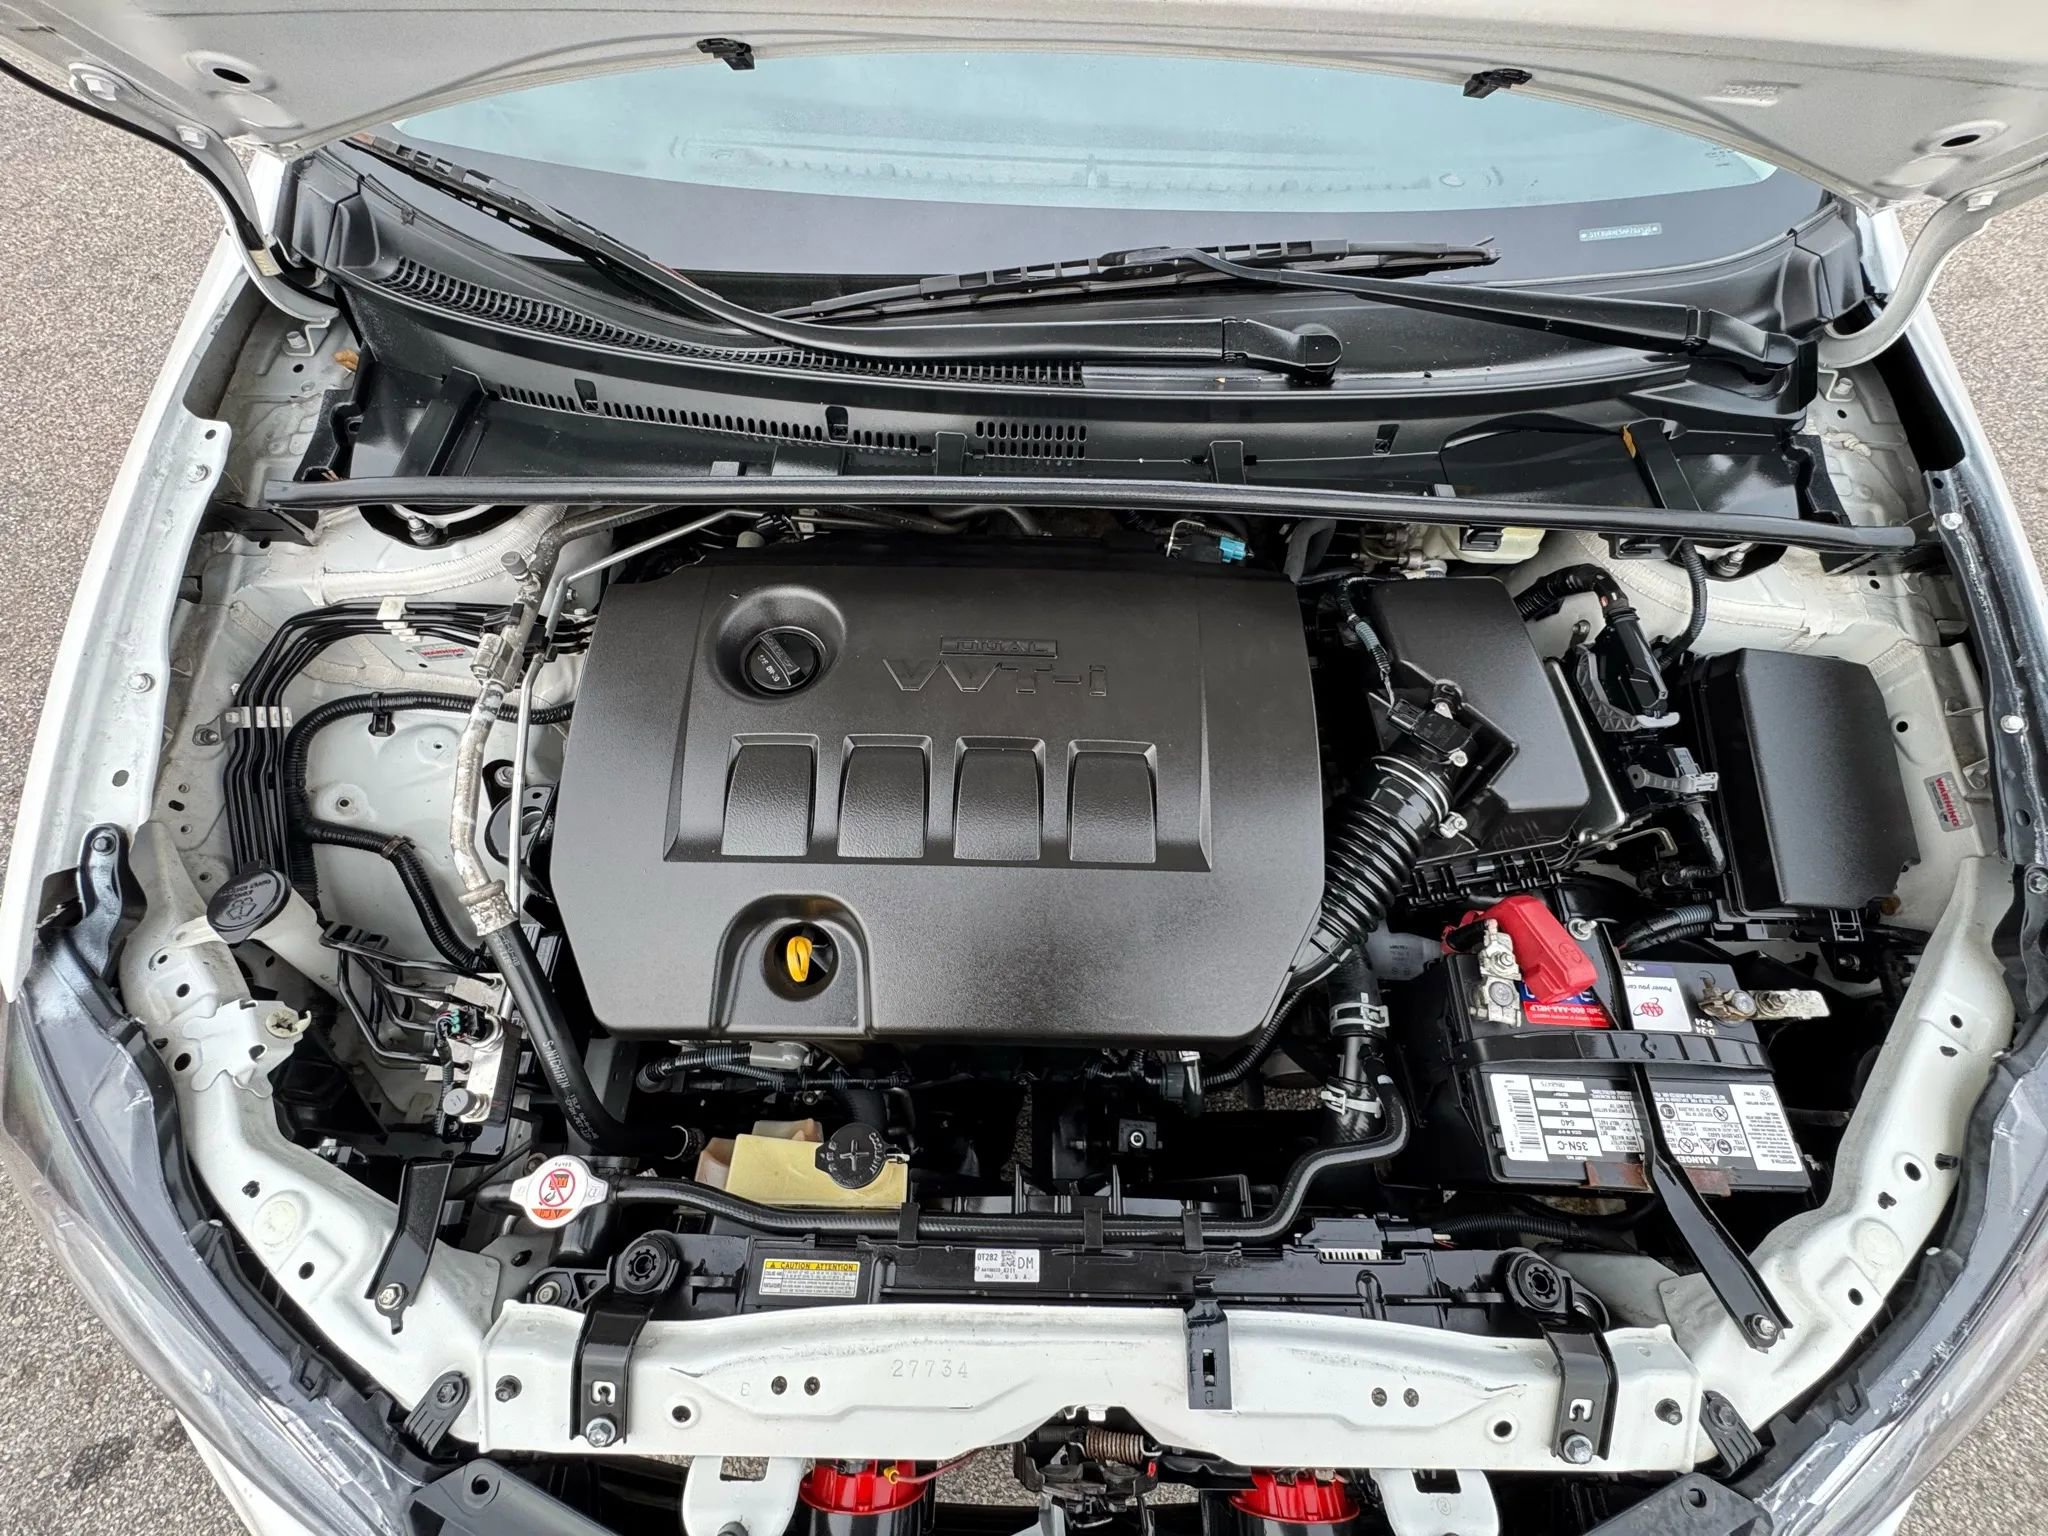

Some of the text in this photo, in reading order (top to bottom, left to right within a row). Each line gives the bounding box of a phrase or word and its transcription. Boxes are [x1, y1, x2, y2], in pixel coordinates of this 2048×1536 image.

[956, 639, 1049, 654] DUAL
[1936, 777, 1960, 826] WARNING
[1694, 1018, 1714, 1027] 9-24
[1696, 1026, 1716, 1035] D-24
[542, 1040, 571, 1089] S-NICHIRIN
[1557, 1141, 1588, 1151] 35N-C
[1675, 1156, 1711, 1165] DANGE
[1018, 1257, 1033, 1269] DM
[891, 1359, 969, 1378] 27734
